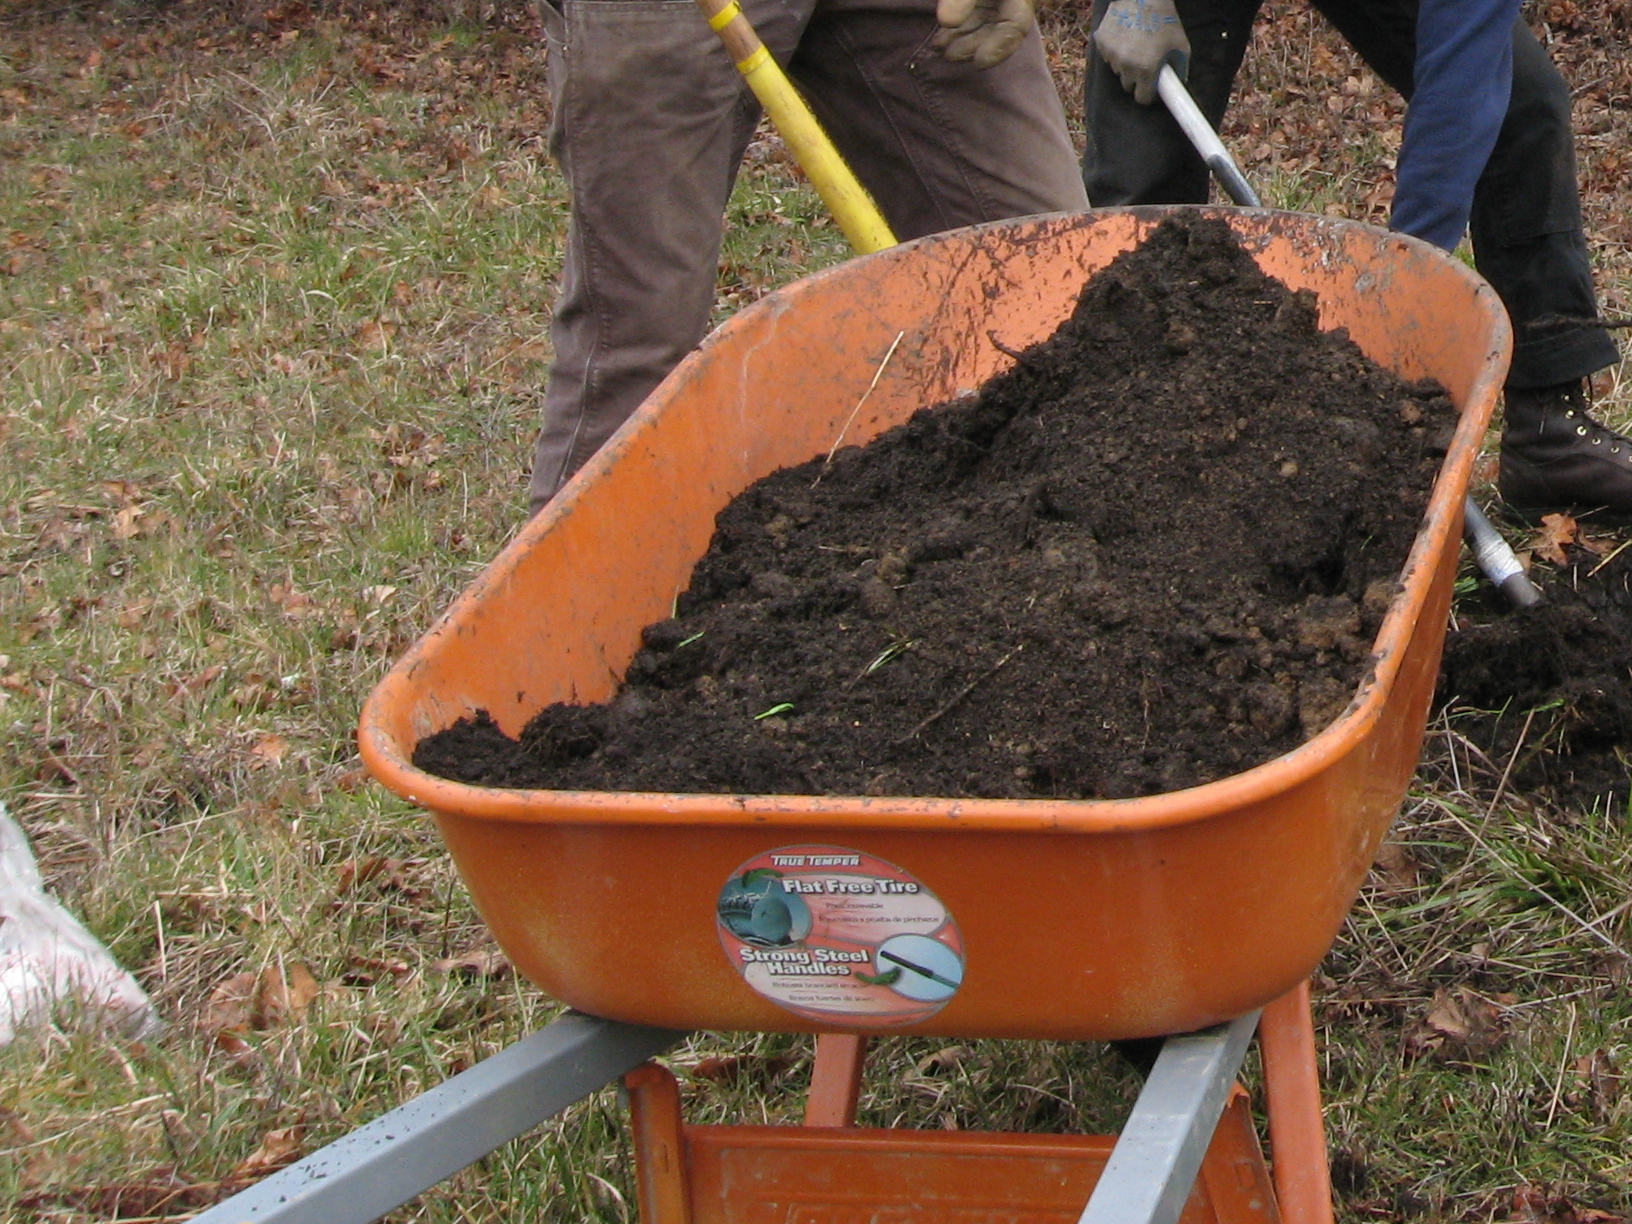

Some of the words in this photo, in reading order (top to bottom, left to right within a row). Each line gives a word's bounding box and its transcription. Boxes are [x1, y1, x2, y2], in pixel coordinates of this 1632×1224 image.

[770, 854, 806, 866] TRUE
[806, 854, 860, 867] TEMPER
[782, 879, 824, 894] Flat
[825, 879, 875, 894] Free
[874, 879, 919, 894] Tire
[740, 948, 811, 966] Strong
[813, 948, 869, 963] Steel
[767, 962, 851, 976] Handles
